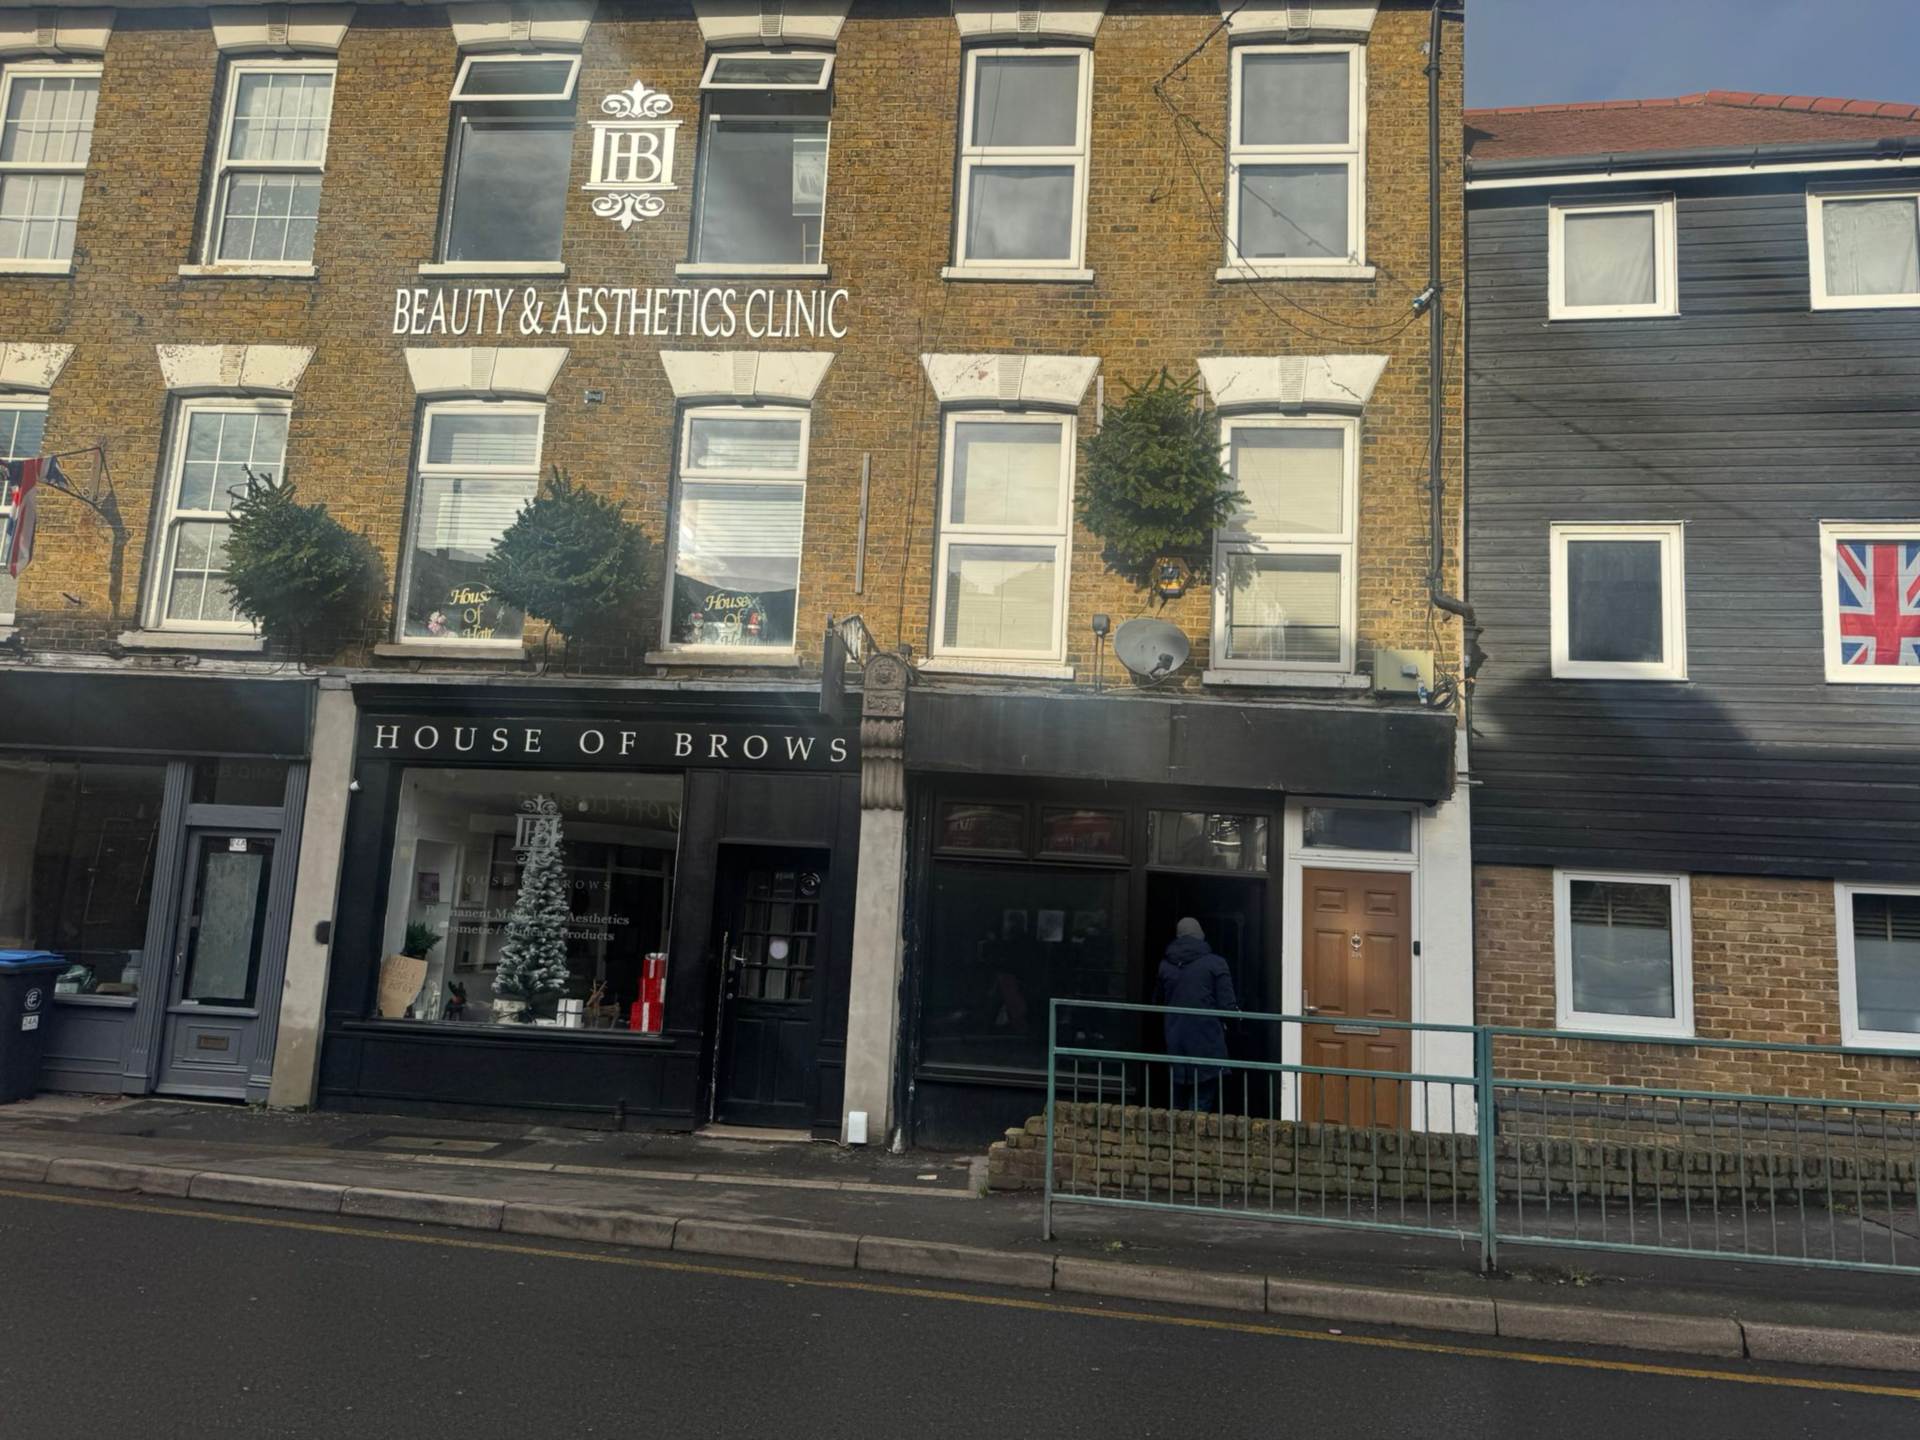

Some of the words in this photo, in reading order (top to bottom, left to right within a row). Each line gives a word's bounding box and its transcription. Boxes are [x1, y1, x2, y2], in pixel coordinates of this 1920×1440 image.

[392, 287, 514, 335] BEAUTY
[519, 286, 544, 336] &
[551, 287, 737, 337] AESTHETICS
[745, 288, 849, 338] CLINIC
[704, 593, 749, 611] House
[373, 725, 542, 753] HOUSE
[579, 729, 637, 755] OF
[675, 732, 847, 762] BROWS
[463, 873, 513, 887] OUSE
[560, 878, 611, 891] ROWS
[567, 911, 630, 925] Aesthetics
[559, 927, 616, 941] Products
